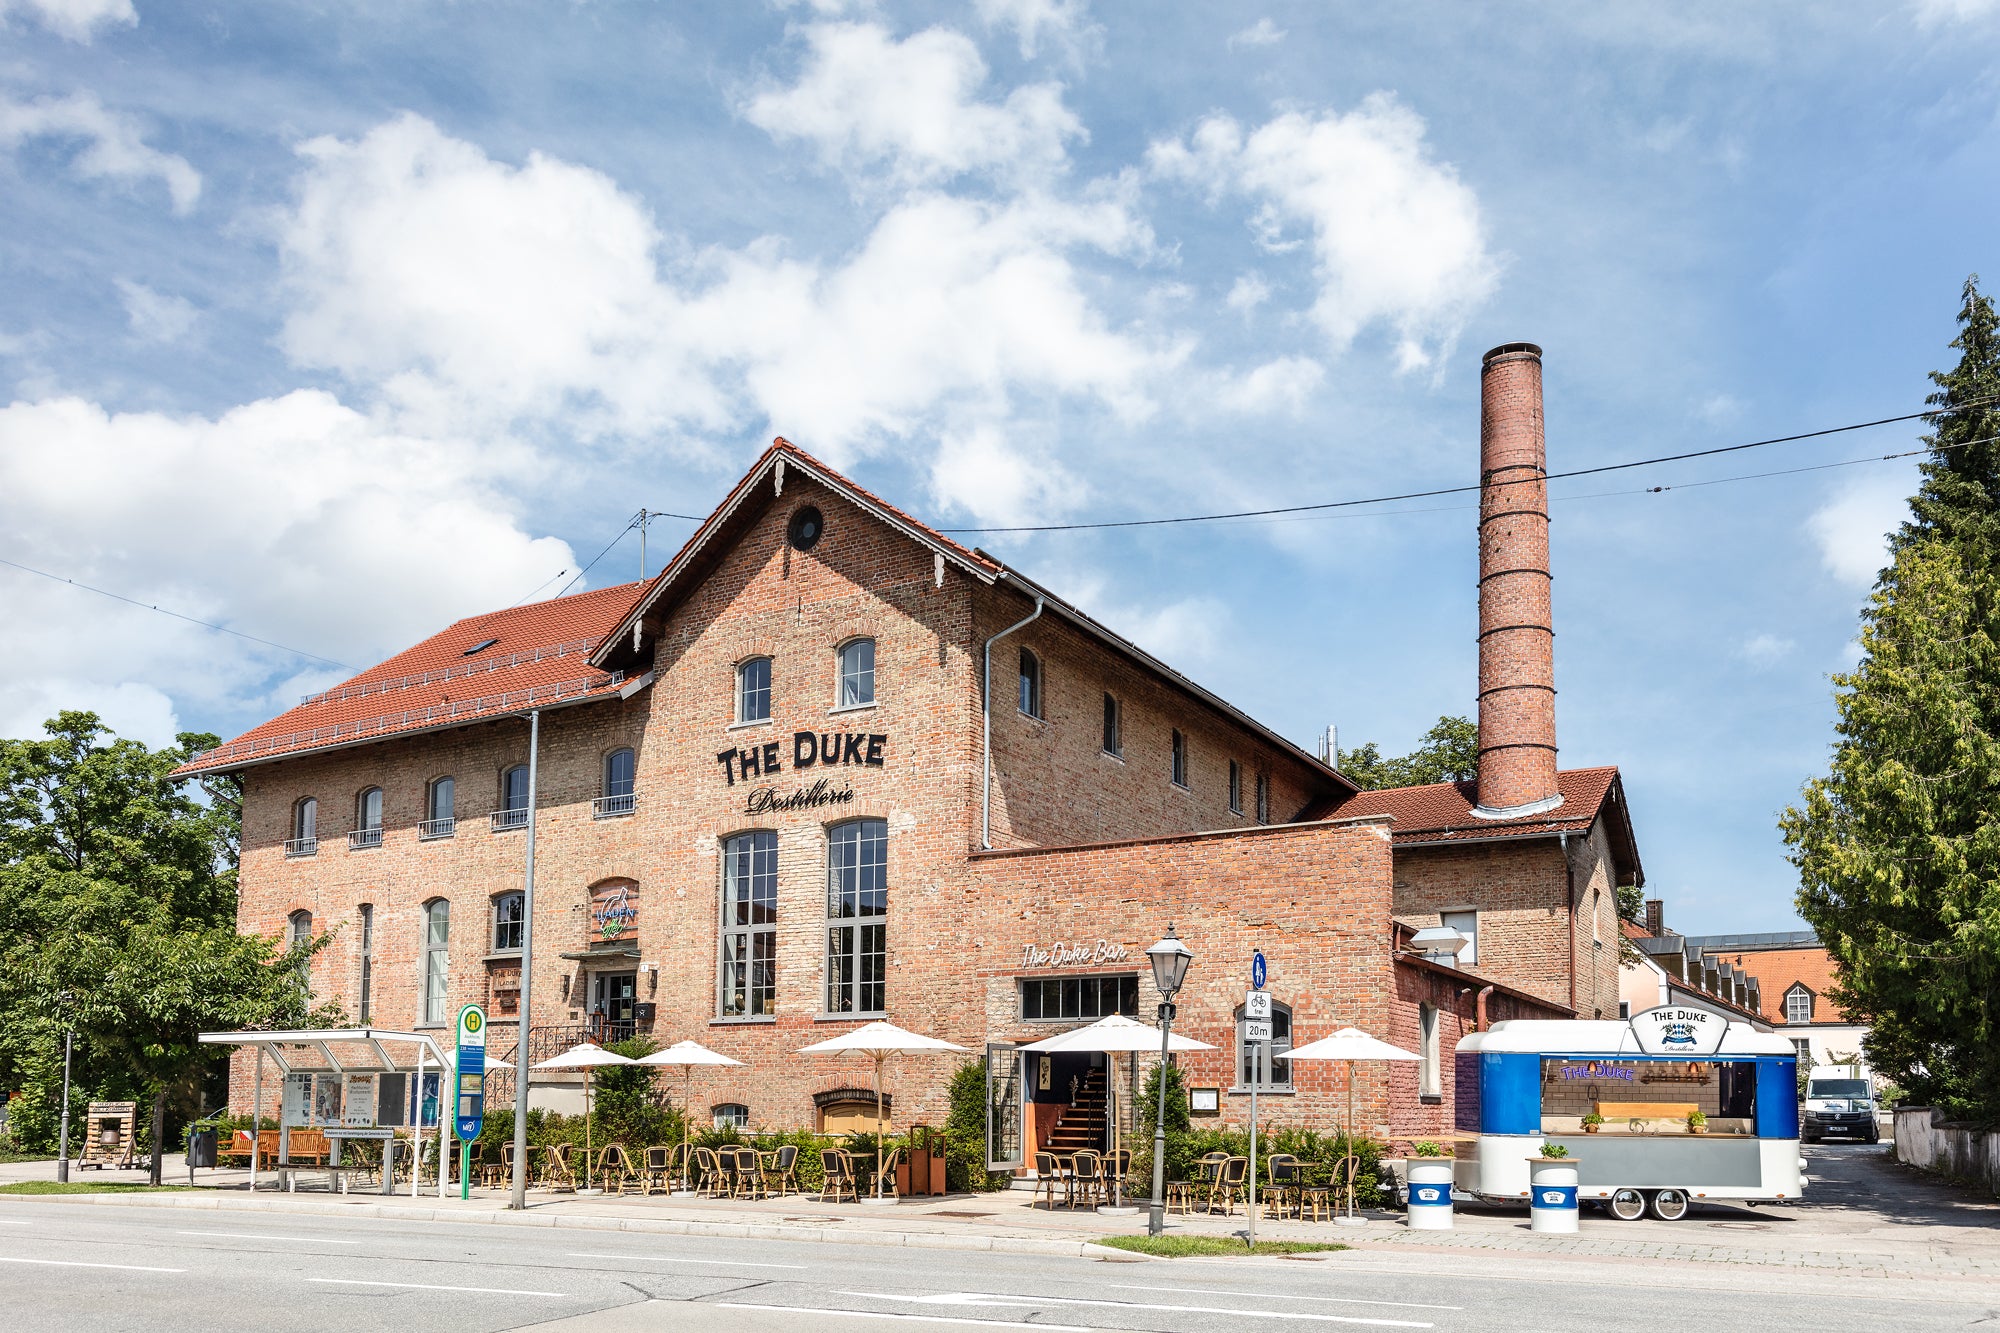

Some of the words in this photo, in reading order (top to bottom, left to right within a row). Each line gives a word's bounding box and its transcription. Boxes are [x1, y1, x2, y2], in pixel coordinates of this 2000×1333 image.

[717, 741, 781, 786] THE
[793, 731, 887, 768] DUKE
[744, 778, 854, 816] Destillerie
[596, 908, 635, 921] LADEN
[1022, 944, 1050, 968] The
[1050, 941, 1092, 965] Duke
[1094, 940, 1127, 963] Bar
[470, 1015, 478, 1028] H
[1652, 1011, 1673, 1022] THE
[1677, 1010, 1707, 1022] DUKE
[1561, 1066, 1590, 1080] THE
[1595, 1064, 1634, 1080] DUKE
